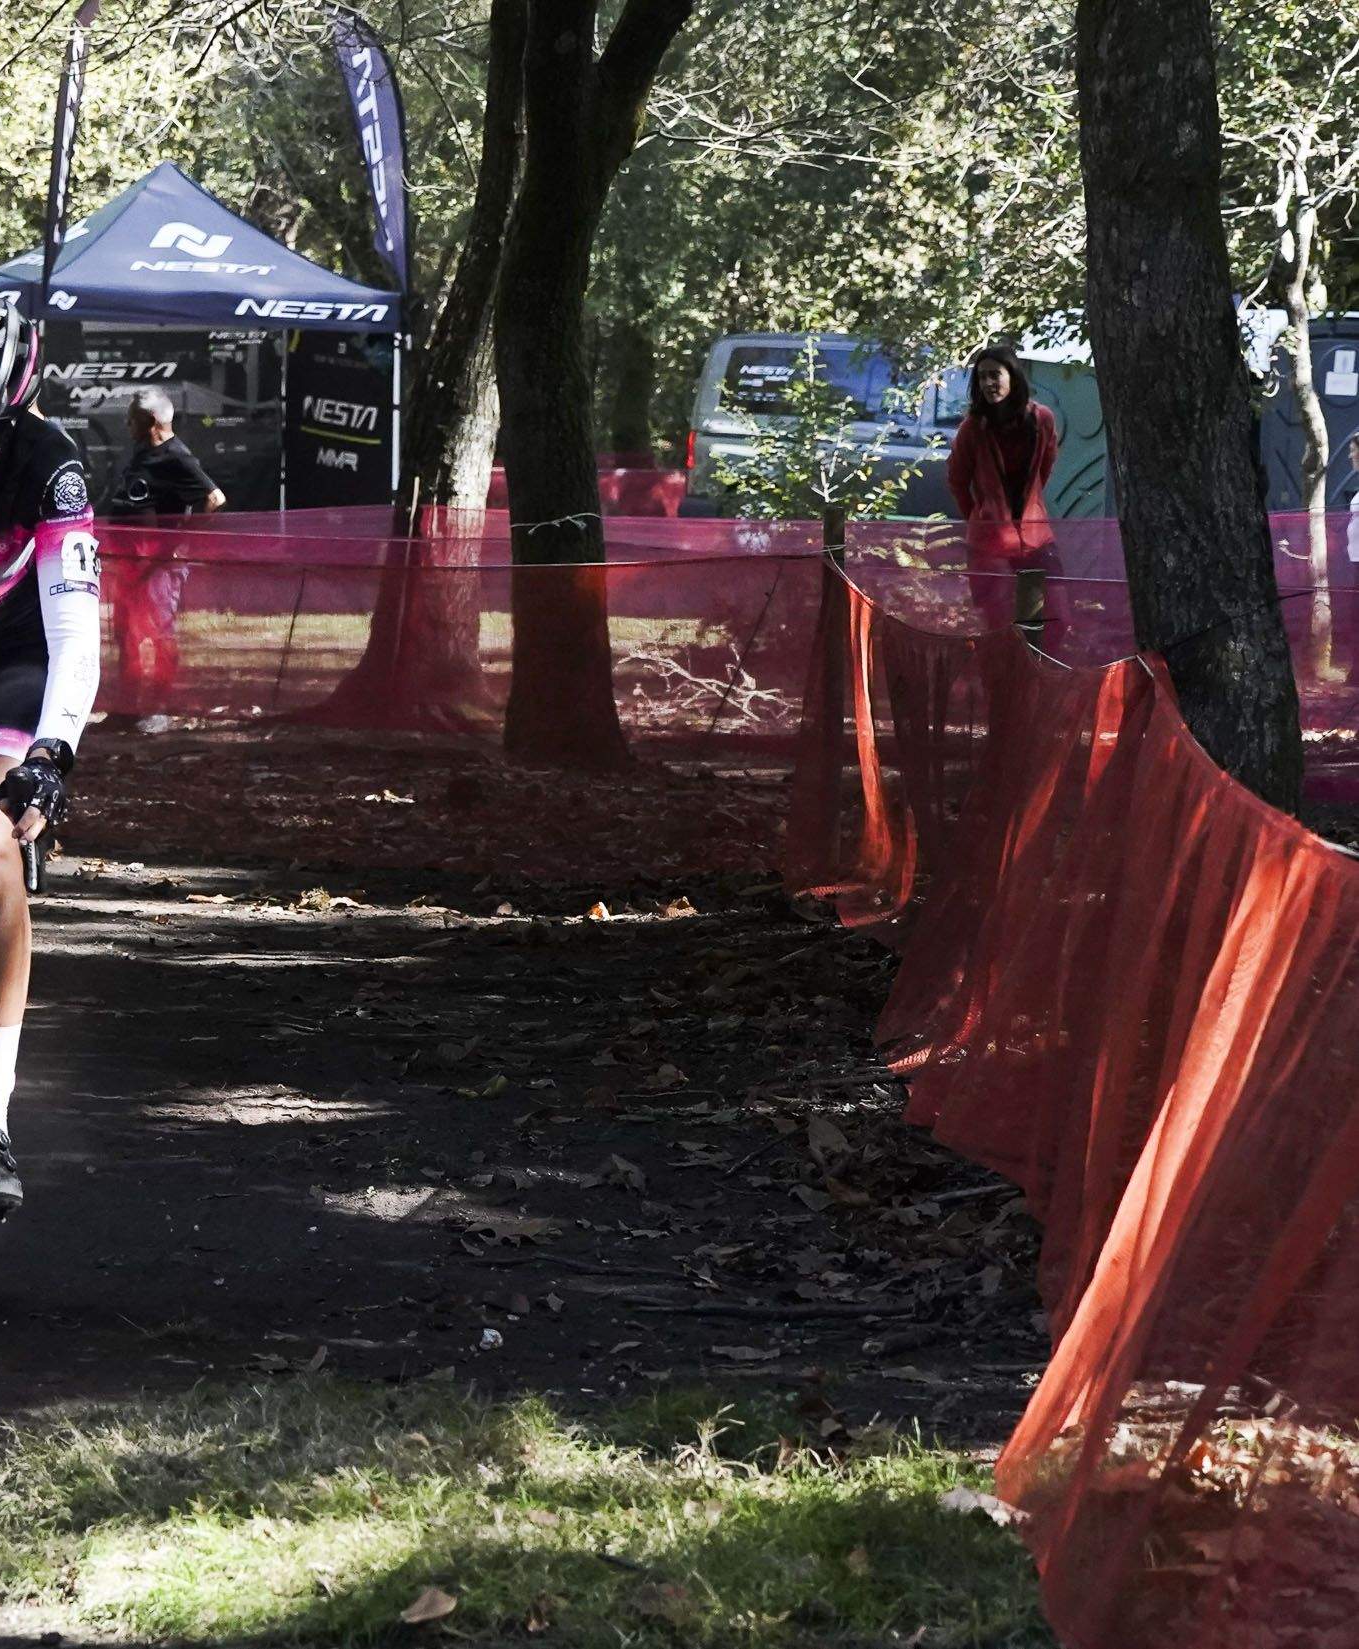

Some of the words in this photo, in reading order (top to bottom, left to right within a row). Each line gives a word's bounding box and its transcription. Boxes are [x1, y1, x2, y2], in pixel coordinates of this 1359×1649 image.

[130, 260, 275, 276] NESTA
[234, 298, 389, 322] NESTA
[43, 362, 178, 379] NESTA
[302, 395, 379, 432] NESTA
